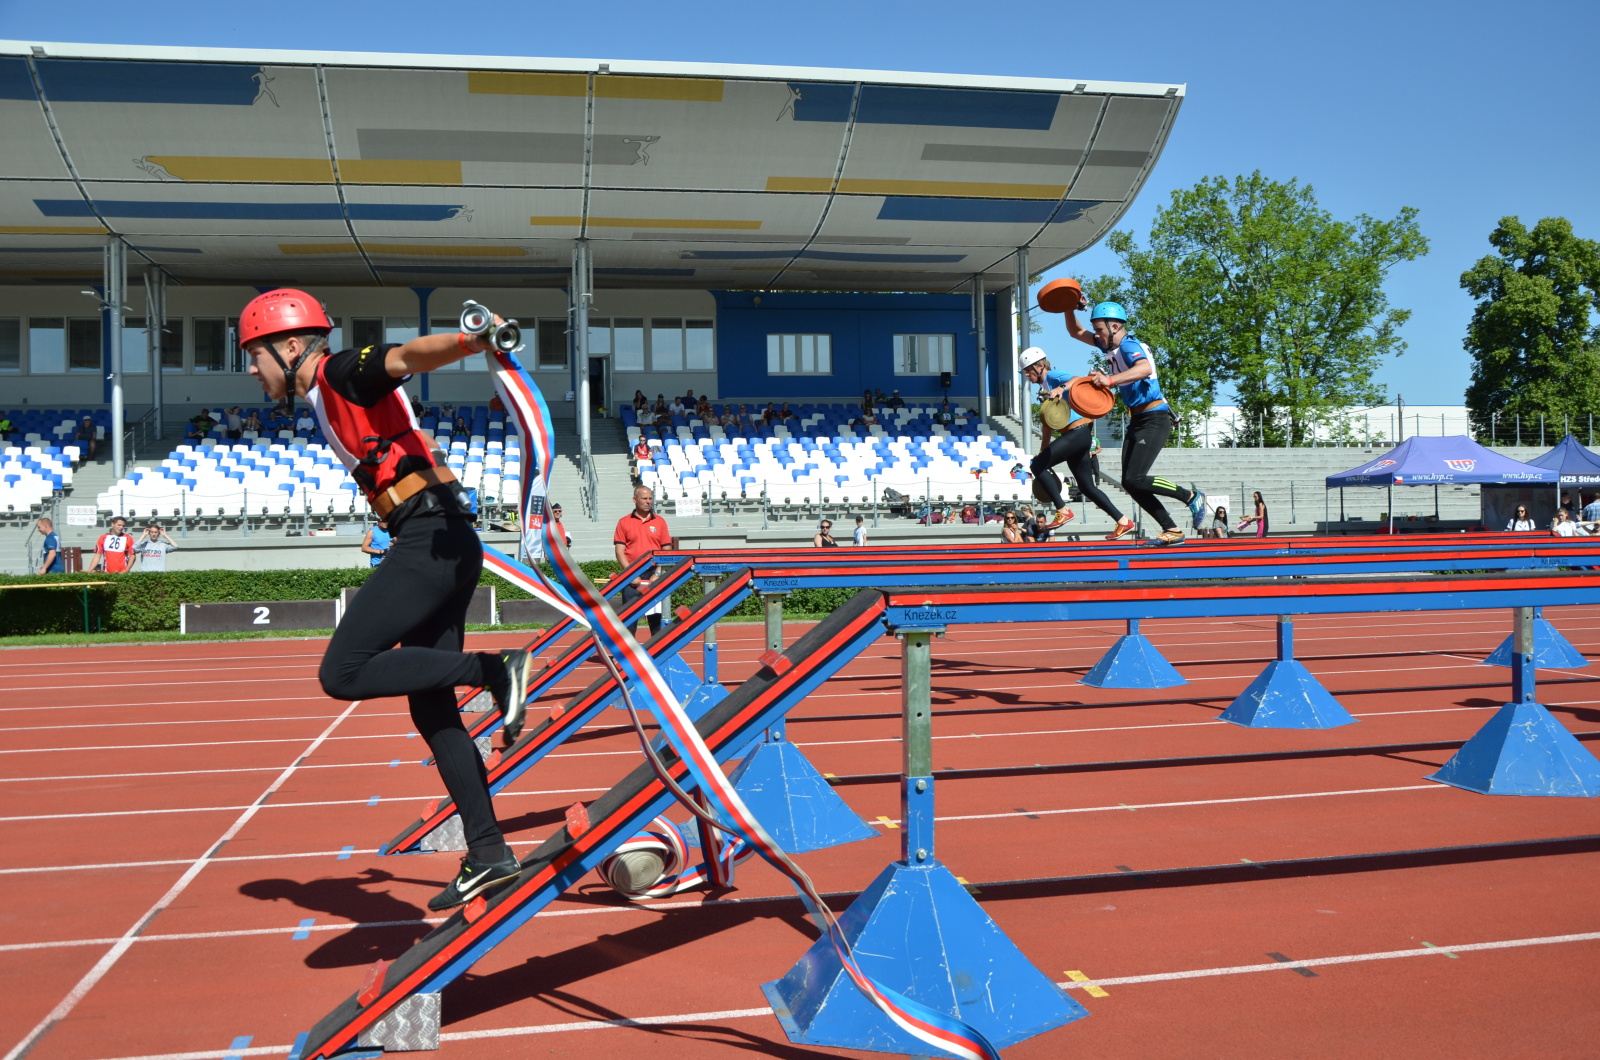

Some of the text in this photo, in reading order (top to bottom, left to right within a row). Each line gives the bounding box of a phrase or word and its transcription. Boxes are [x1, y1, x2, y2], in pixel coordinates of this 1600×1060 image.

[1412, 473, 1454, 482] www.hvp.cz
[1502, 472, 1543, 481] www.hvp.cz
[1560, 475, 1577, 483] HZS
[108, 536, 121, 550] 26
[763, 578, 799, 587] Knezek.cz
[253, 606, 271, 625] 2
[904, 609, 957, 621] Knezek.cz
